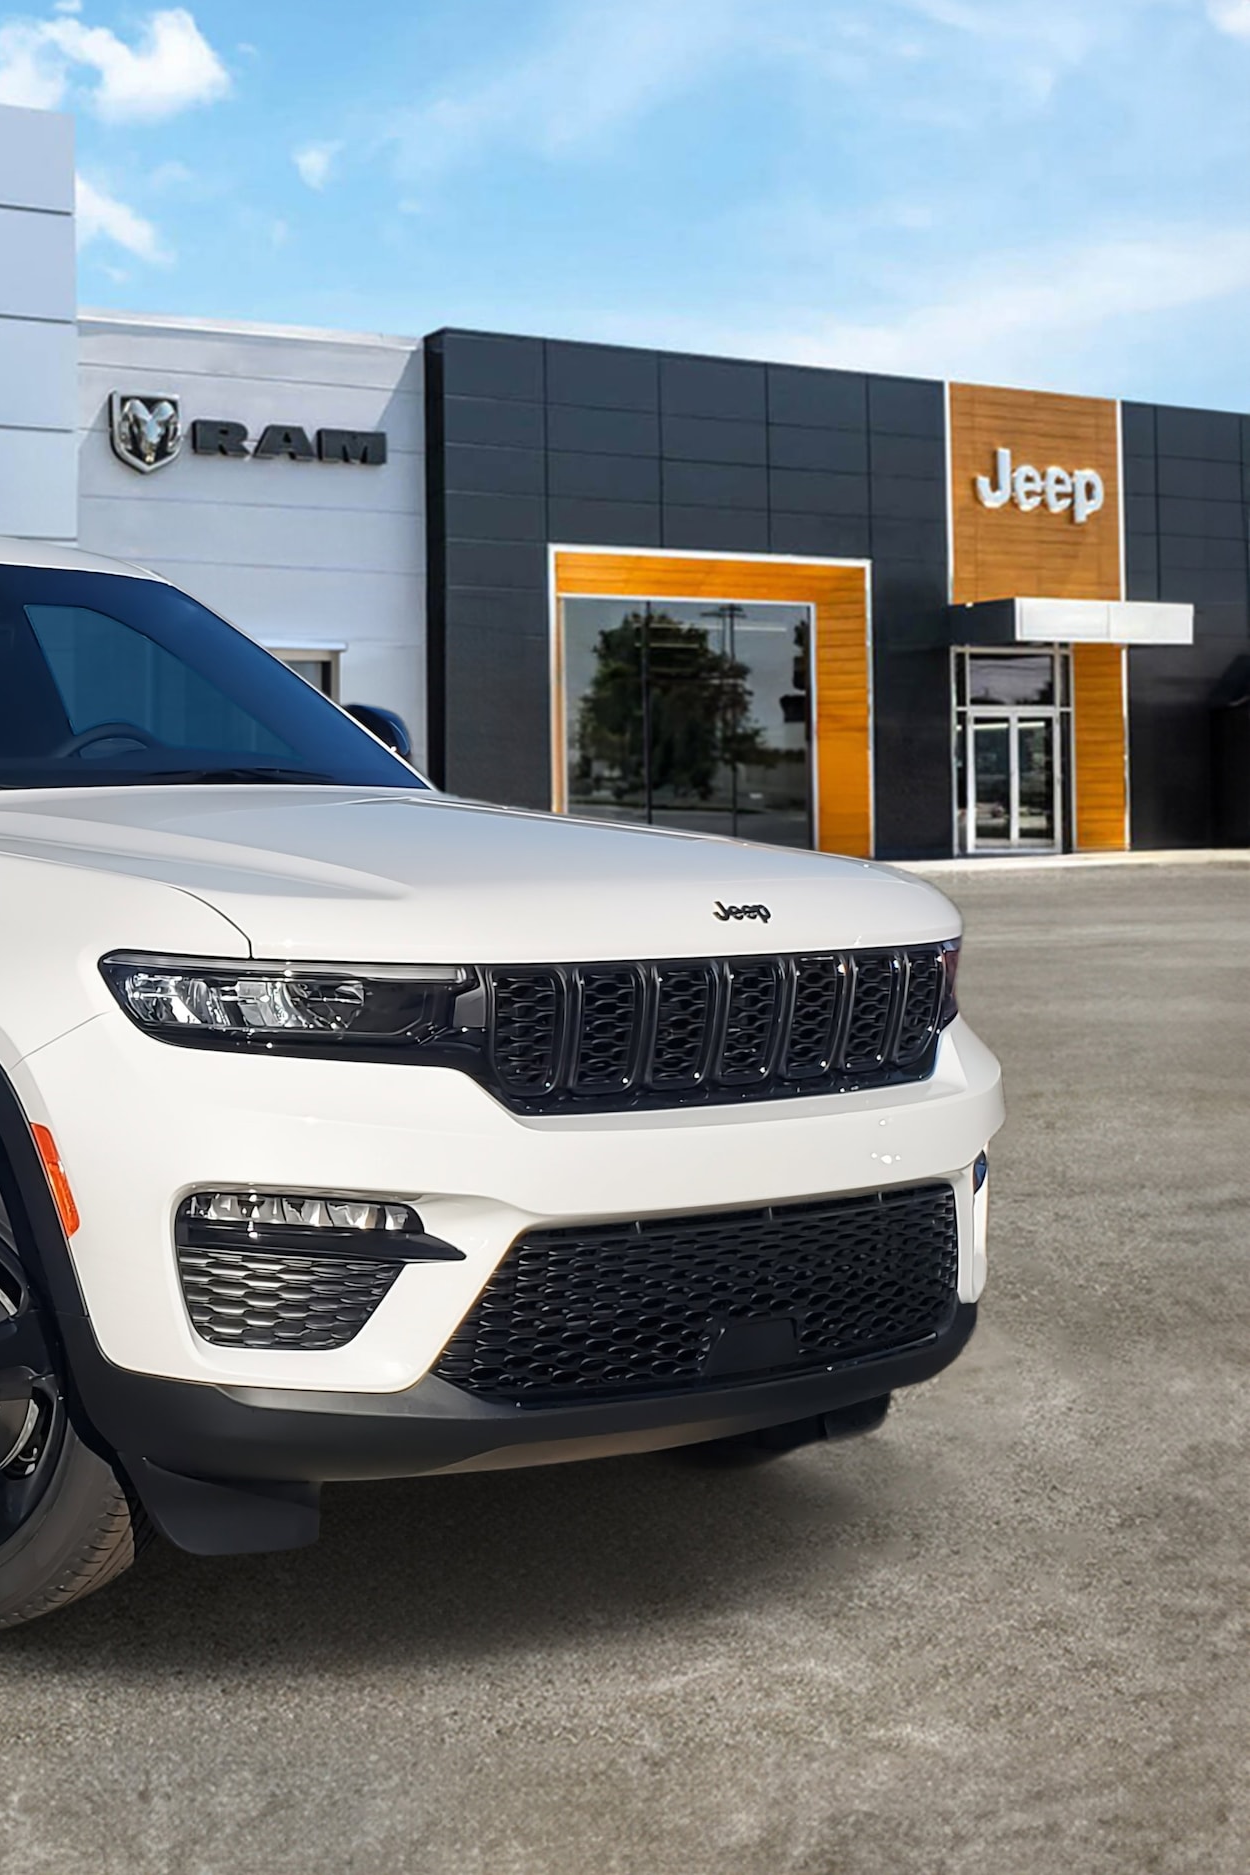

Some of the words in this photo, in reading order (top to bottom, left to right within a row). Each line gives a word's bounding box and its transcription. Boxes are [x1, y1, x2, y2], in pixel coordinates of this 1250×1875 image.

[191, 418, 388, 466] RAM
[975, 446, 1105, 524] Jeep
[712, 900, 772, 924] Jeep
